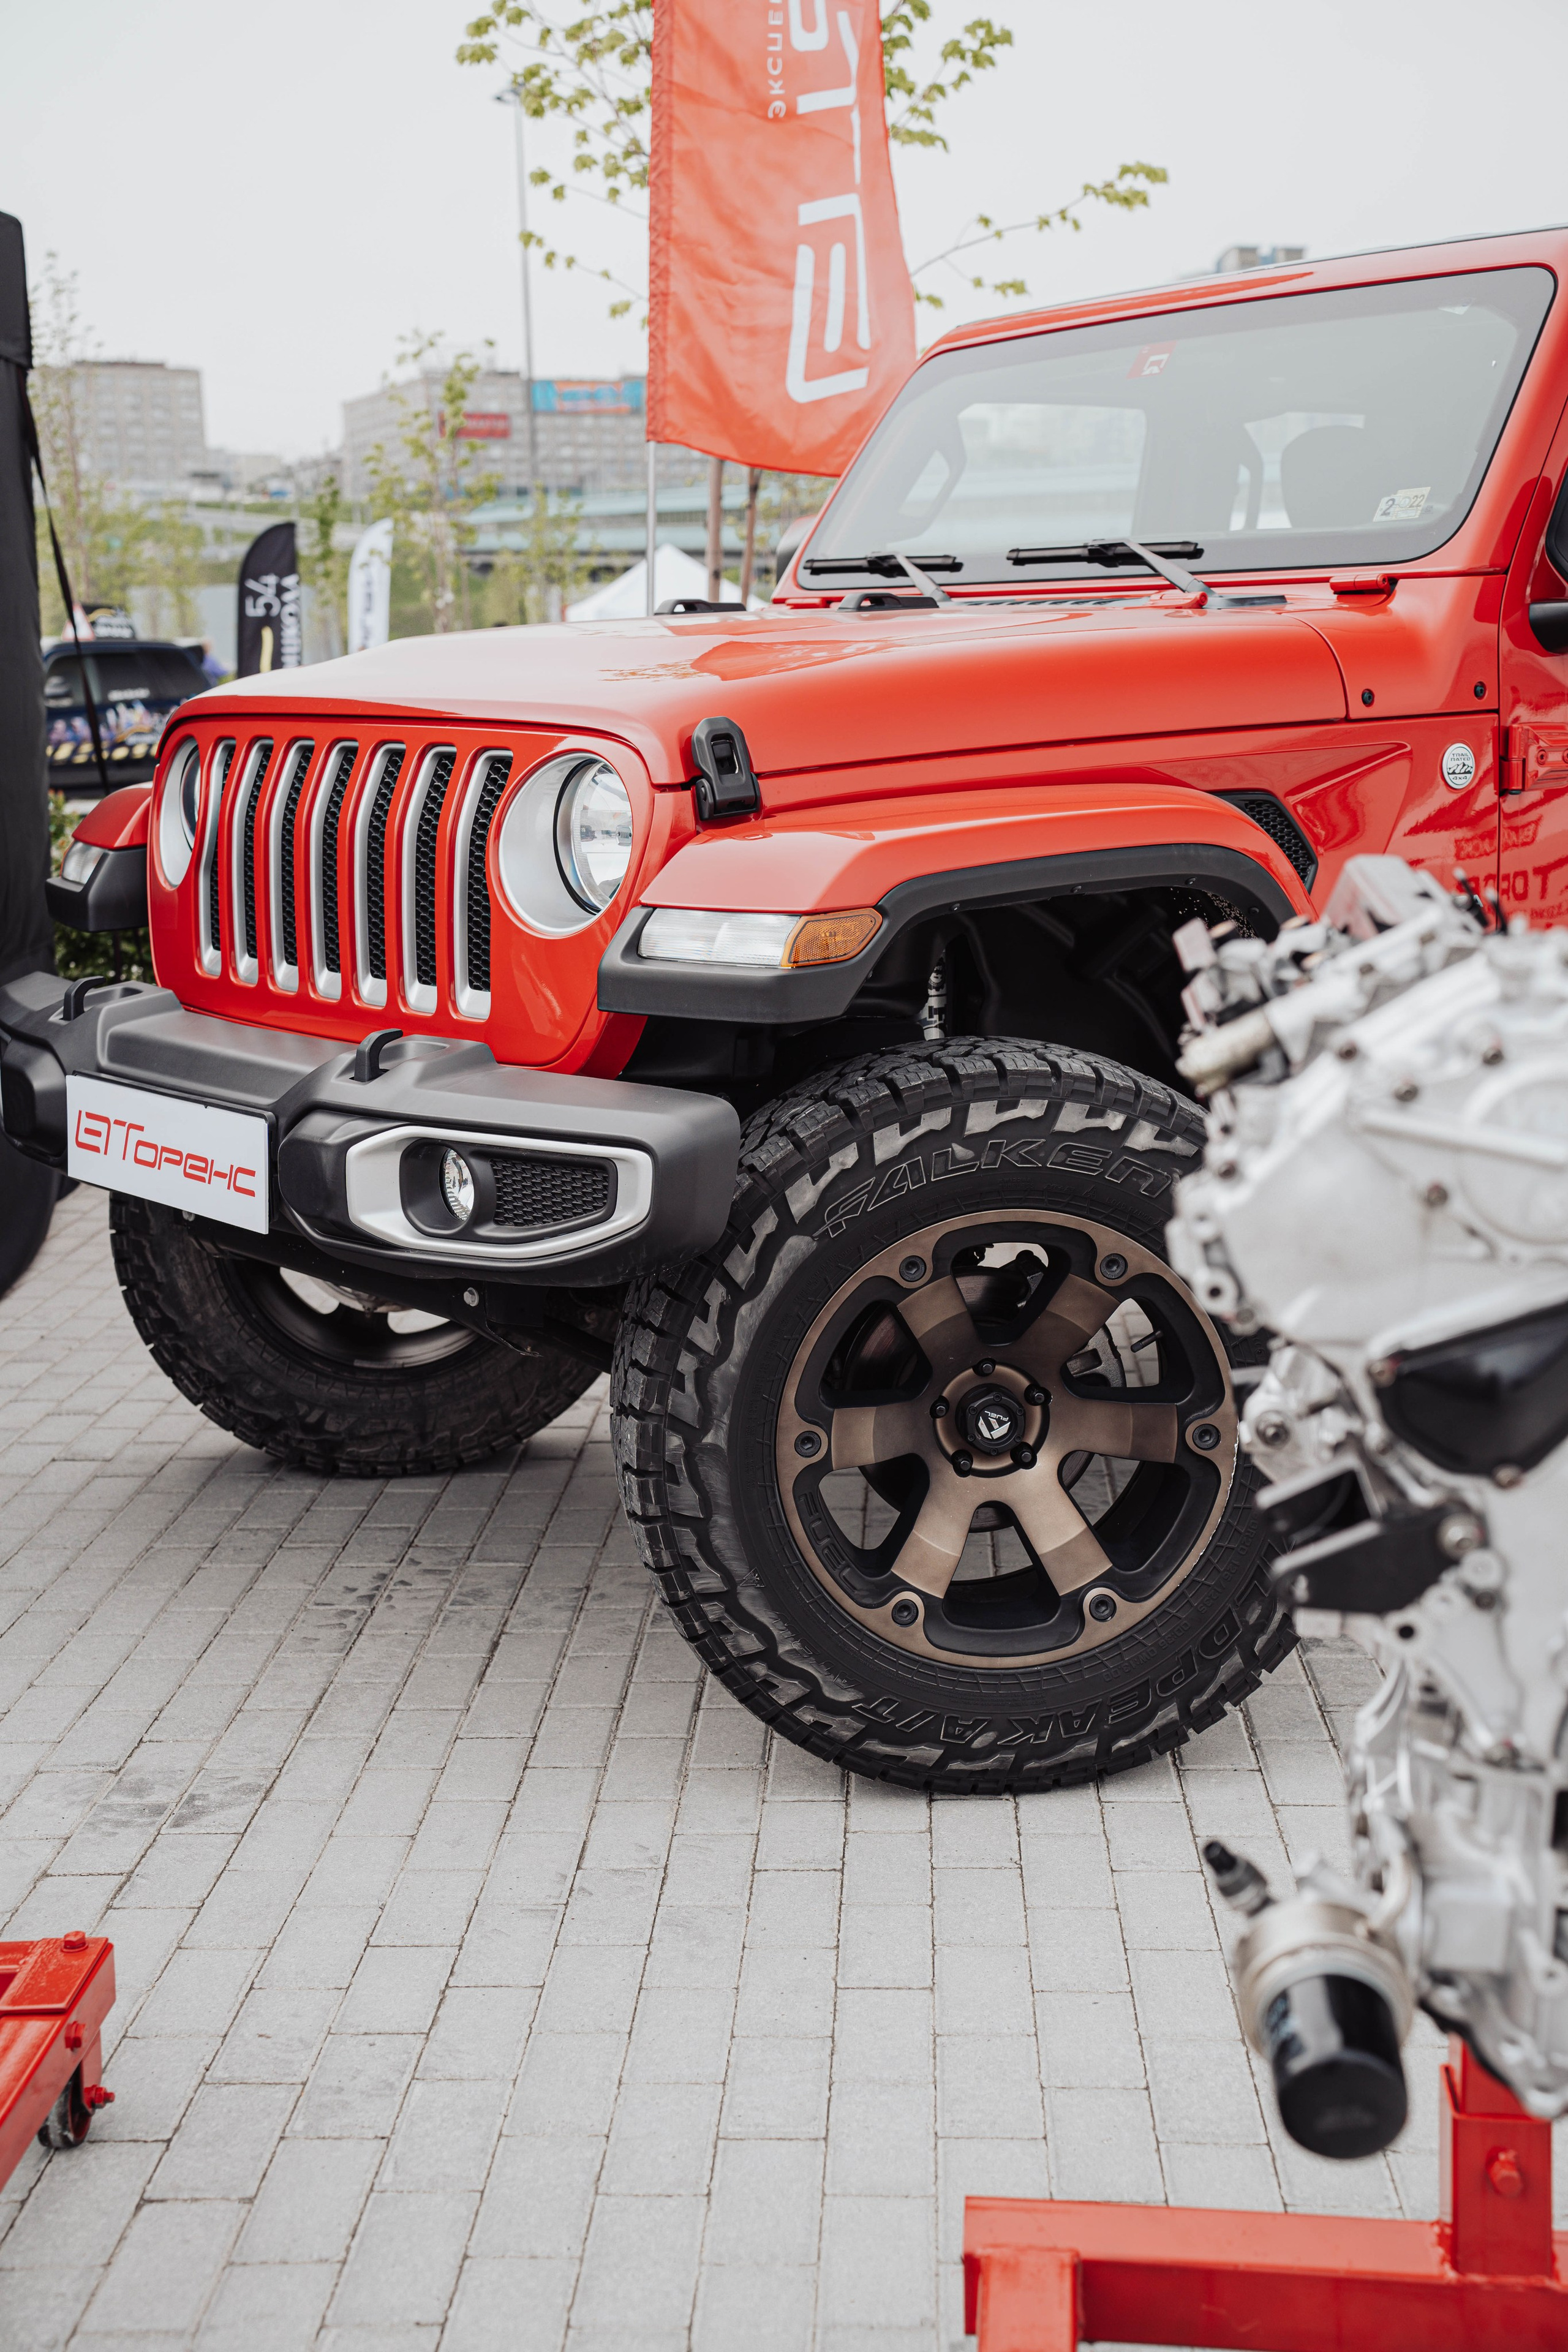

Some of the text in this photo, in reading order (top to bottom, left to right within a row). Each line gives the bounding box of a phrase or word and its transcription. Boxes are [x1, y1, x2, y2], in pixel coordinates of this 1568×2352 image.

[244, 573, 281, 617] 54
[984, 1411, 1009, 1422] FUEL
[797, 1493, 859, 1594] FUEL
